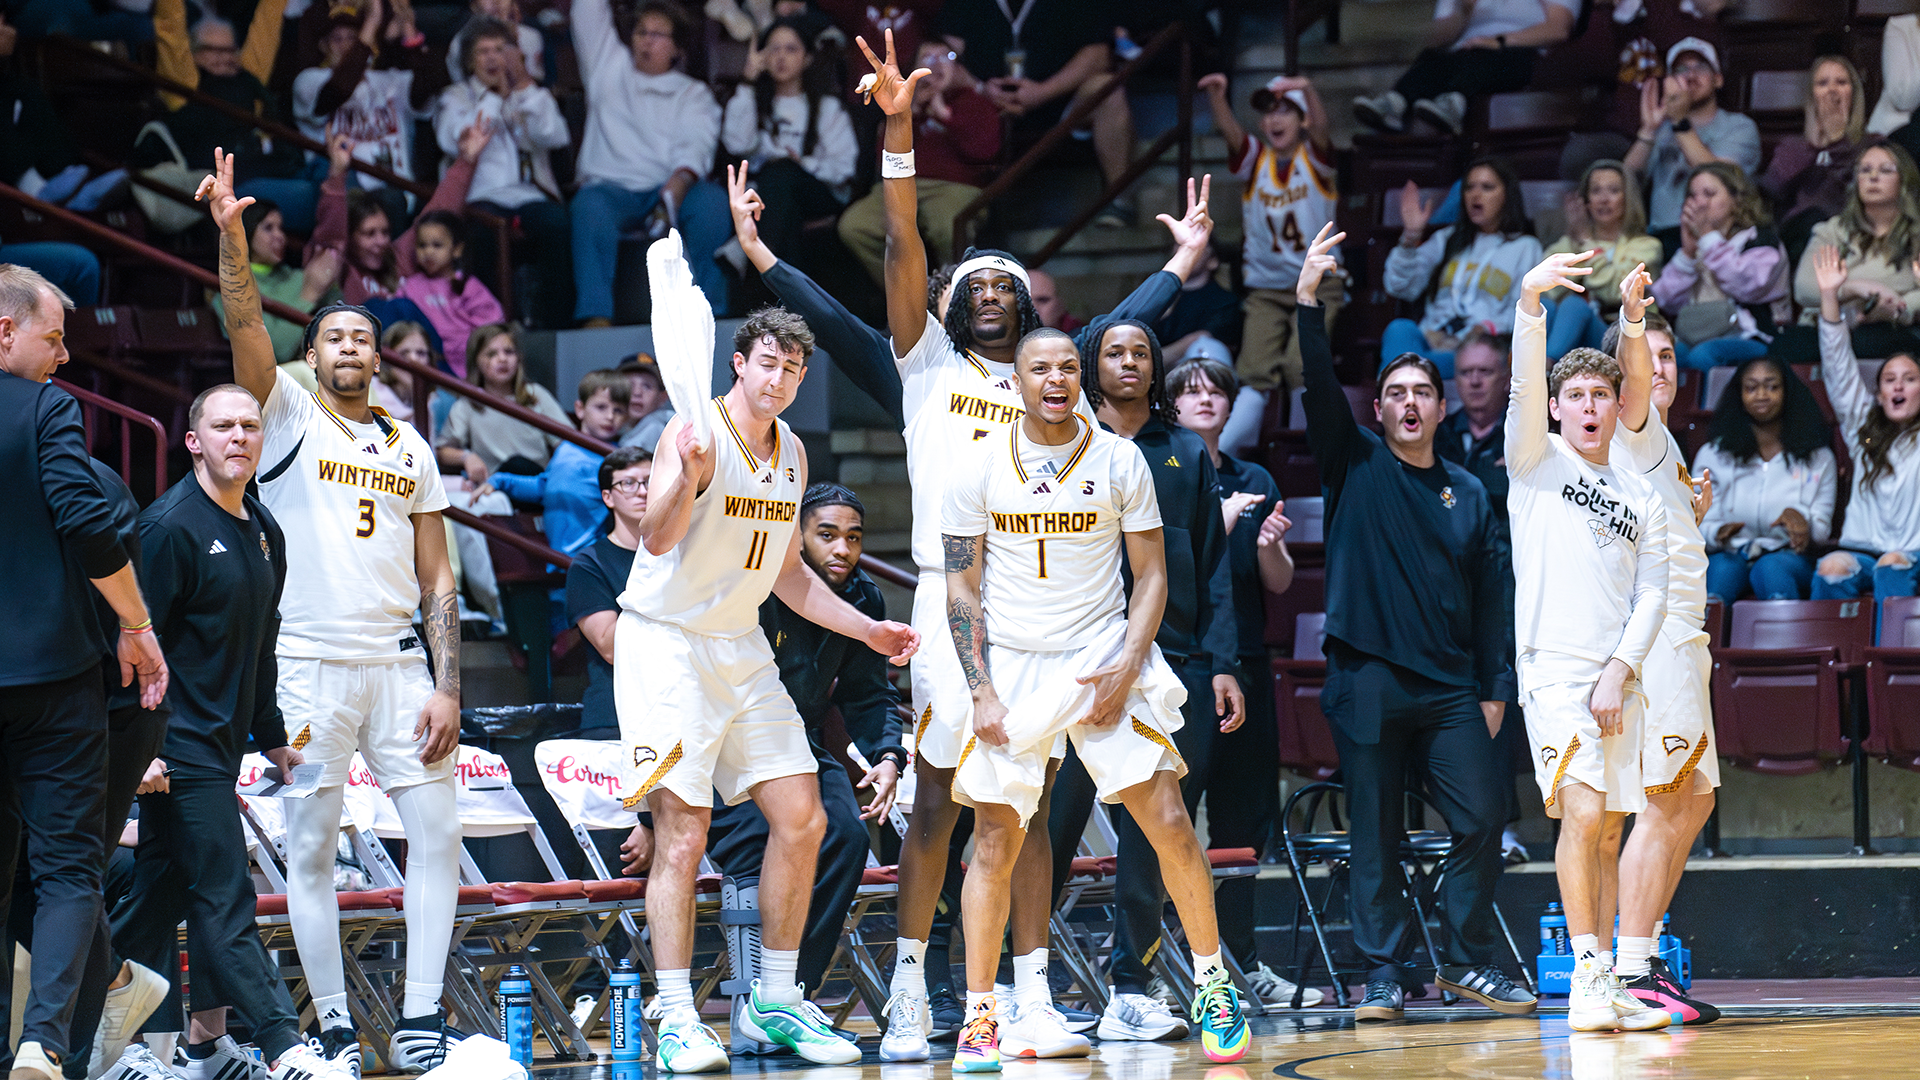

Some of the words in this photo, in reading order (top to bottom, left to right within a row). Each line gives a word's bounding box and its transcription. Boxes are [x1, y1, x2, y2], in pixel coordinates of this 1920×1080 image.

[1266, 210, 1306, 253] 14
[318, 459, 417, 500] WINTHROP
[1562, 483, 1607, 517] ROC
[355, 498, 377, 539] 3
[724, 494, 797, 523] WINTHROP
[990, 510, 1098, 535] WINTHROP
[743, 529, 769, 571] 11
[1036, 537, 1049, 579] 1
[453, 754, 510, 786] oplas
[546, 755, 623, 796] Corop
[1545, 971, 1572, 980] POW
[500, 995, 508, 1042] POWERA
[613, 987, 626, 1048] POWERADE
